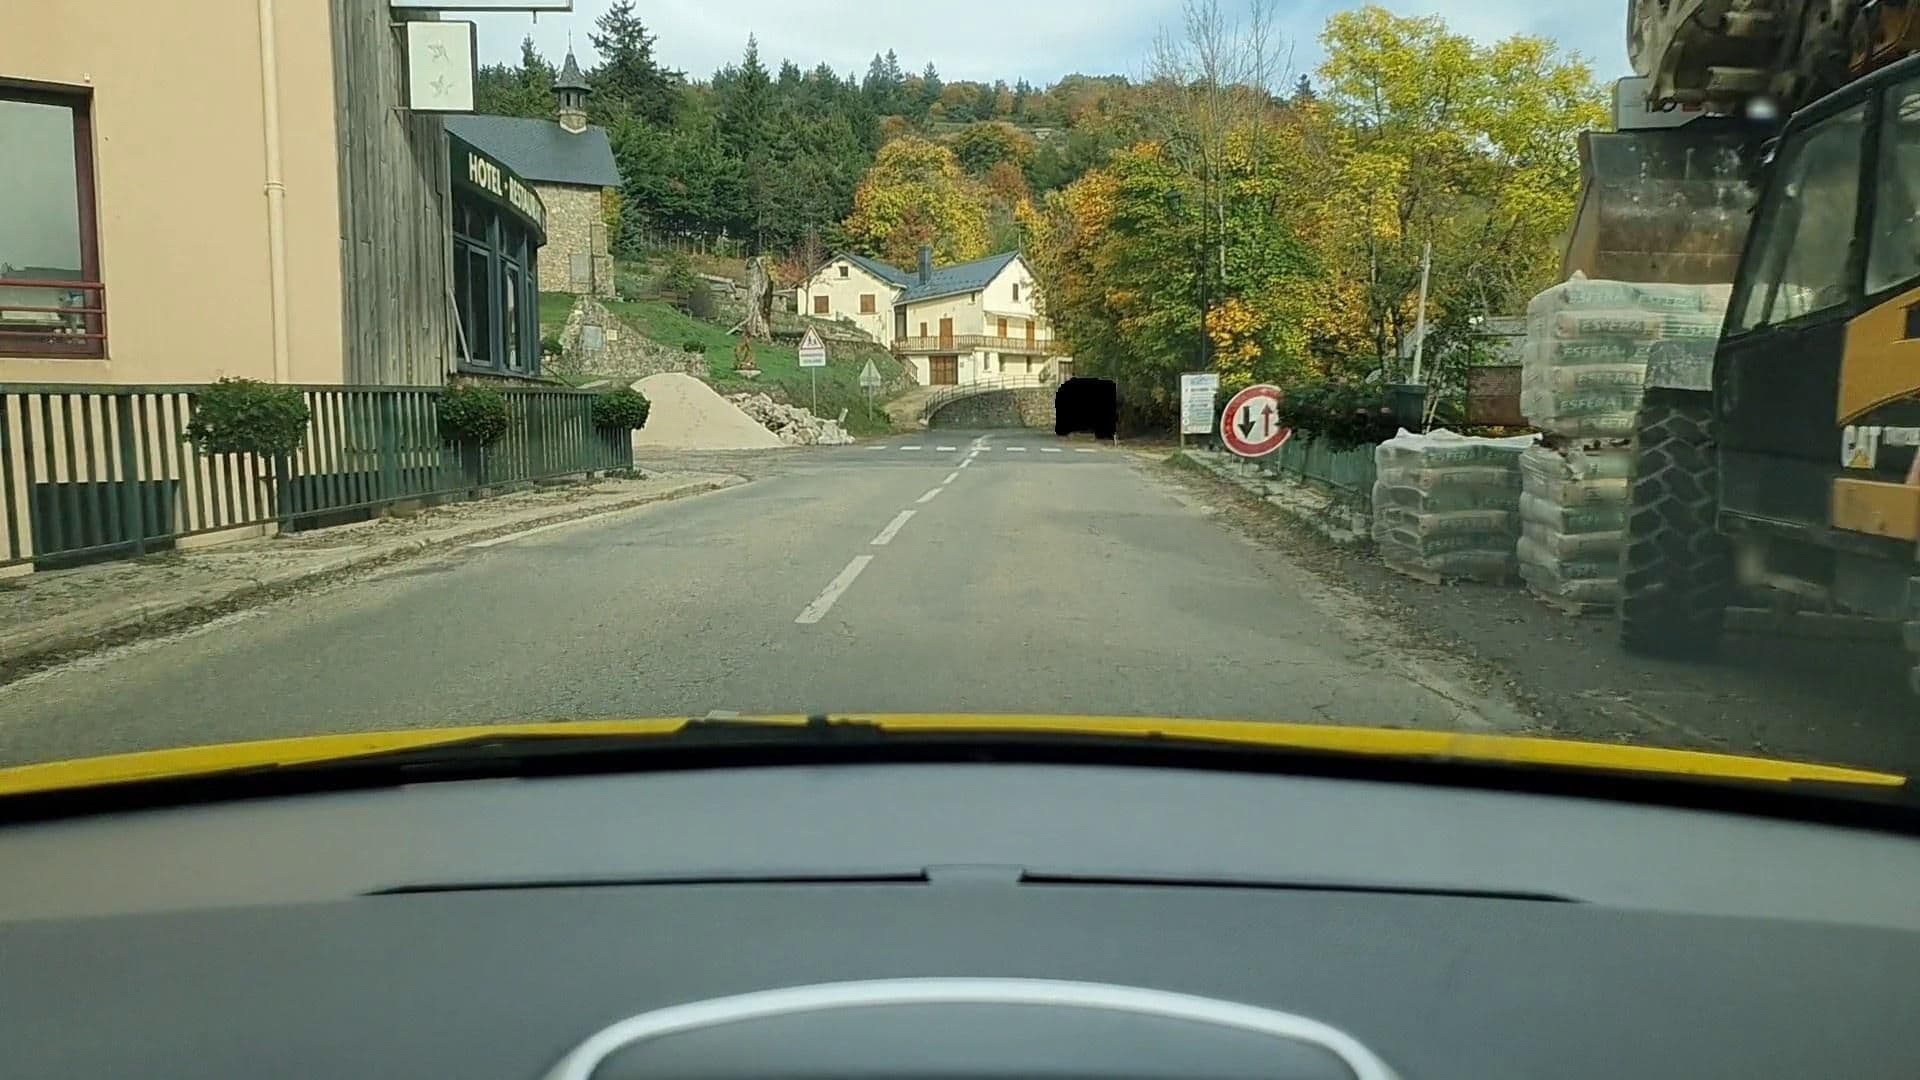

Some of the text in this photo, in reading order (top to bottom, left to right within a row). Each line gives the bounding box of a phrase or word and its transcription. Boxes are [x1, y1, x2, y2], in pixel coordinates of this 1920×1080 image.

[468, 151, 503, 197] HOTEL
[1581, 319, 1643, 333] ESFERA
[1563, 344, 1627, 357] ESFERA
